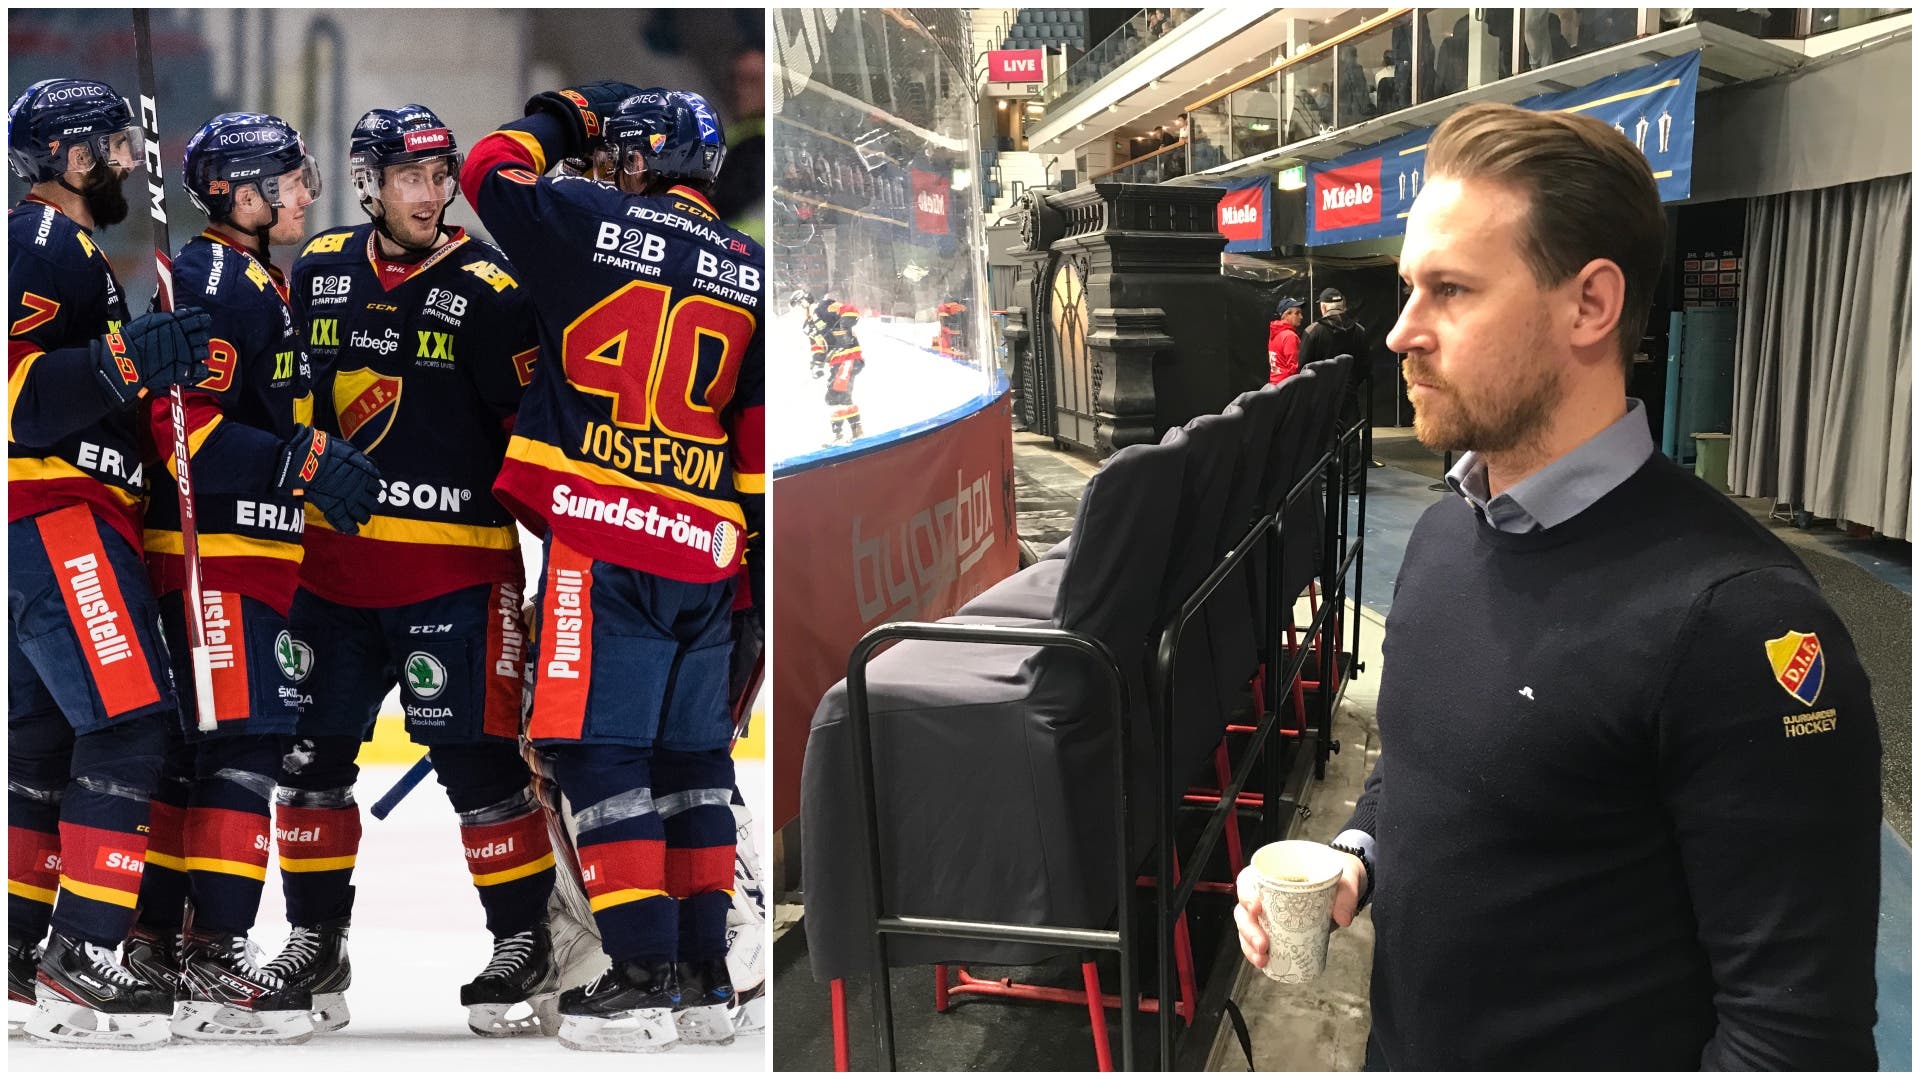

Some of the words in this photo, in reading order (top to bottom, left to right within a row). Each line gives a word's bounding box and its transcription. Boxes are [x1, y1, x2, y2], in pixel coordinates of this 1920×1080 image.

[1003, 59, 1036, 72] LIVE
[48, 86, 103, 103] ROTOTEC
[63, 125, 93, 135] CCM
[220, 130, 279, 146] ROTOTEC
[410, 133, 445, 146] Miele
[620, 130, 643, 138] CCM
[49, 141, 59, 156] 7
[140, 94, 167, 224] CCM
[230, 168, 261, 178] CCM
[209, 180, 230, 195] 29
[1322, 183, 1374, 211] Miele
[673, 202, 713, 221] CCM
[1222, 204, 1257, 226] Miele
[596, 221, 666, 263] B2B
[627, 206, 730, 249] RIDDERMARK
[729, 240, 751, 257] BIL
[301, 231, 354, 258] ABT
[385, 264, 406, 274] SHL
[460, 260, 519, 293] ABT
[592, 253, 662, 278] IT-PARTNER
[696, 249, 761, 292] B2B
[312, 275, 352, 297] B2B
[692, 277, 758, 308] IT-PARTNER
[10, 291, 60, 336] 7
[366, 303, 399, 312] CCM
[424, 288, 468, 317] B2B
[311, 319, 340, 346] XXL
[350, 330, 398, 355] Fabege
[416, 331, 455, 362] XXL
[562, 279, 757, 446] 40
[580, 421, 724, 491] JOSEFSON
[552, 484, 712, 553] Sundström
[851, 468, 995, 623] byggbox
[64, 553, 133, 666] Puustelli
[409, 623, 454, 634] CCM
[547, 569, 584, 680] Puustelli
[1785, 641, 1817, 683] D.I.F.
[407, 705, 453, 718] ŠKODA
[411, 718, 446, 727] Stockholm
[1785, 717, 1837, 738] HOCKEY
[219, 974, 254, 994] CCM
